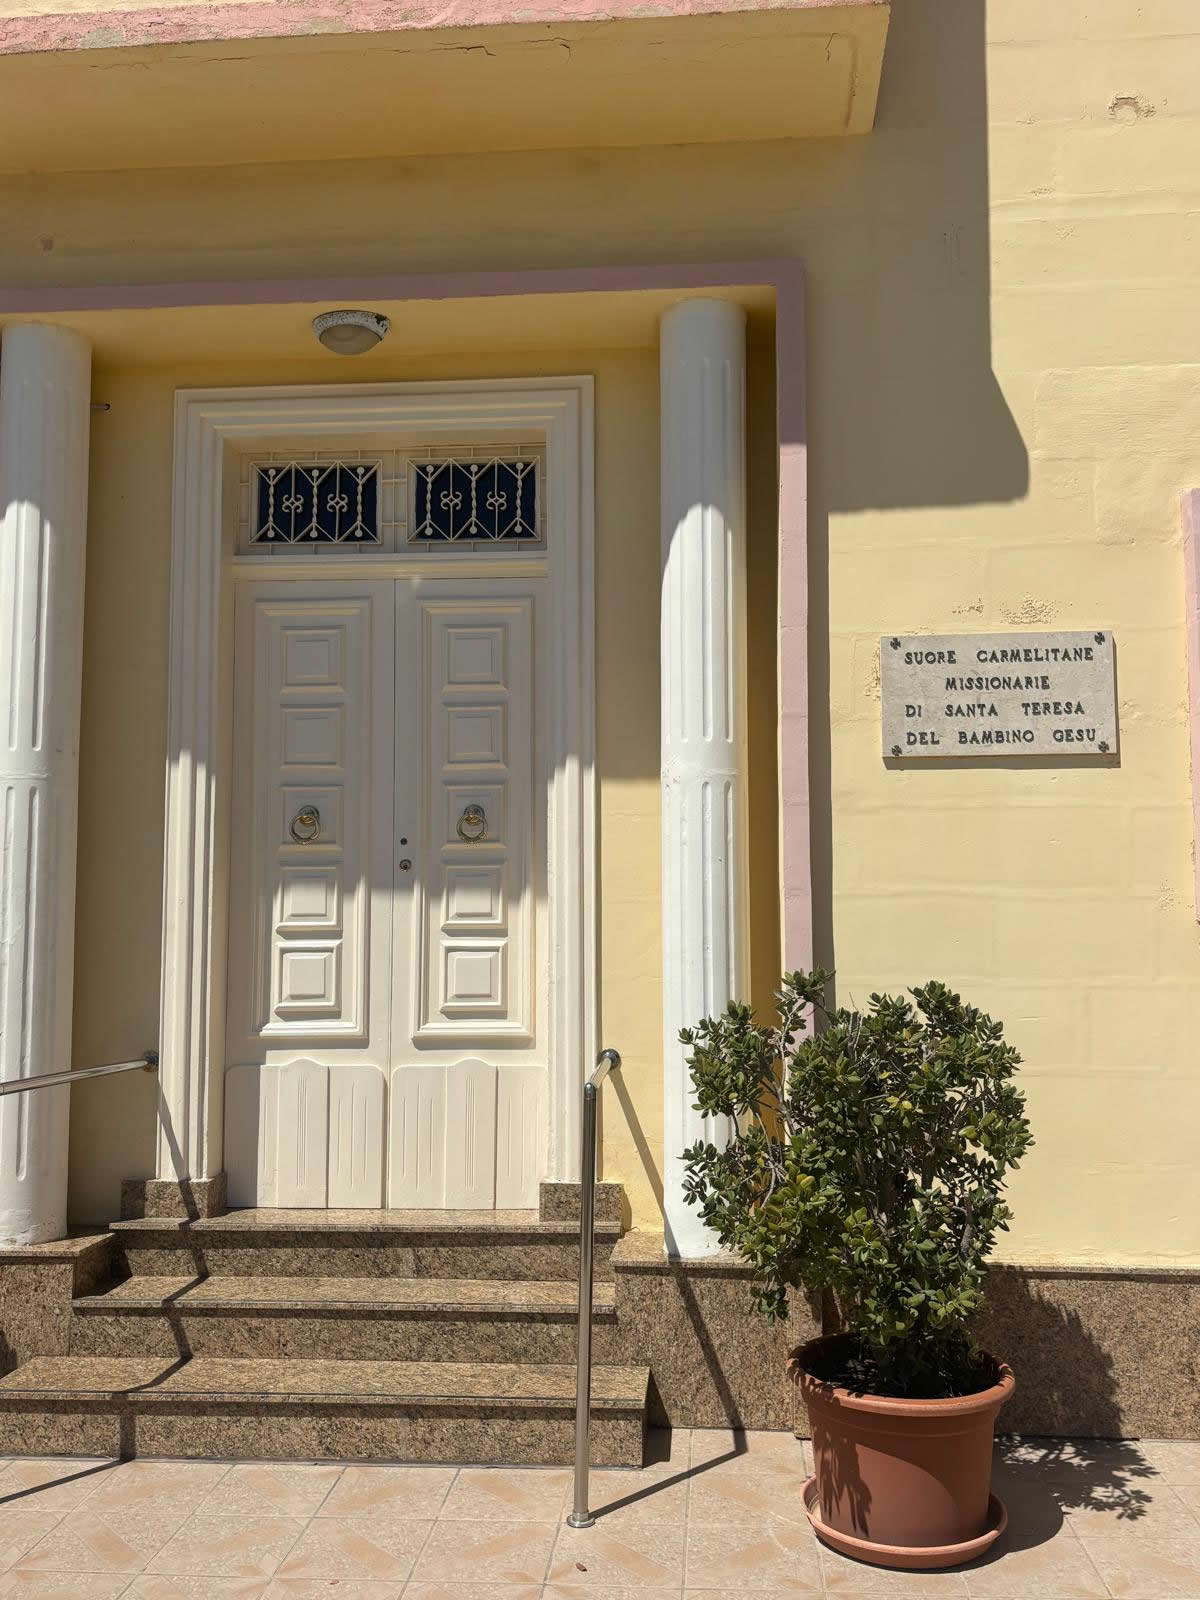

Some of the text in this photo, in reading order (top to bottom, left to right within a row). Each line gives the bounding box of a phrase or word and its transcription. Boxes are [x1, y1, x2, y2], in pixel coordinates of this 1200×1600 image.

[904, 647, 1094, 665] SUORE CARMELITANE
[945, 675, 1050, 691] MISSIONARIE
[905, 701, 1085, 718] DI SANTA TERESA
[906, 728, 1096, 746] DEL BAMBINO GESU
